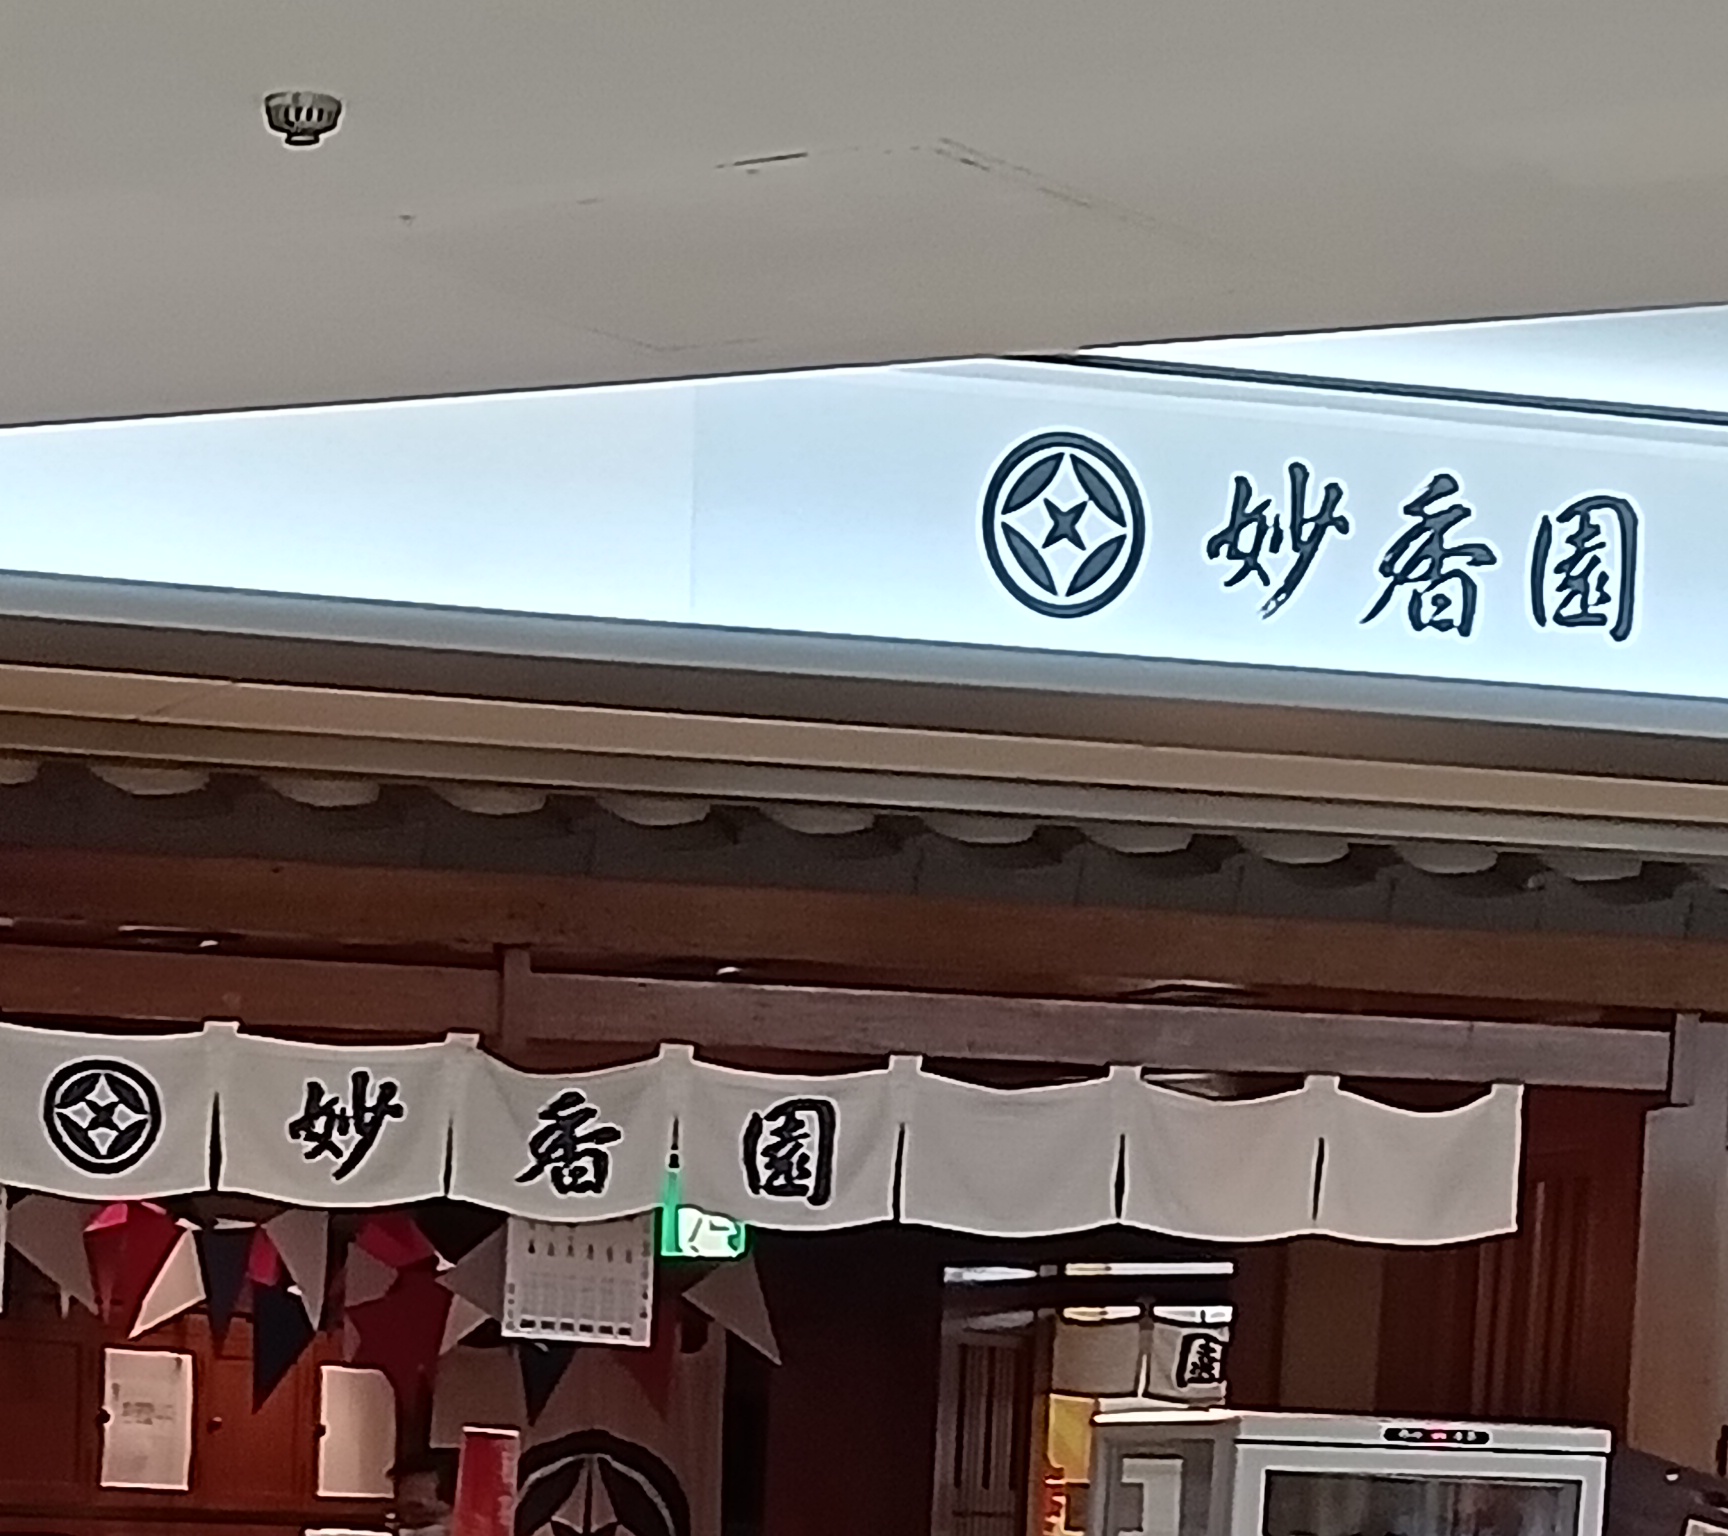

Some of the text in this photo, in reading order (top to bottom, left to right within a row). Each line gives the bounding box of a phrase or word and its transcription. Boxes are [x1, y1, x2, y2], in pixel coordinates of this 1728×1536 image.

[1205, 460, 1640, 642] 妙香園
[287, 1068, 839, 1207] 妙香園
